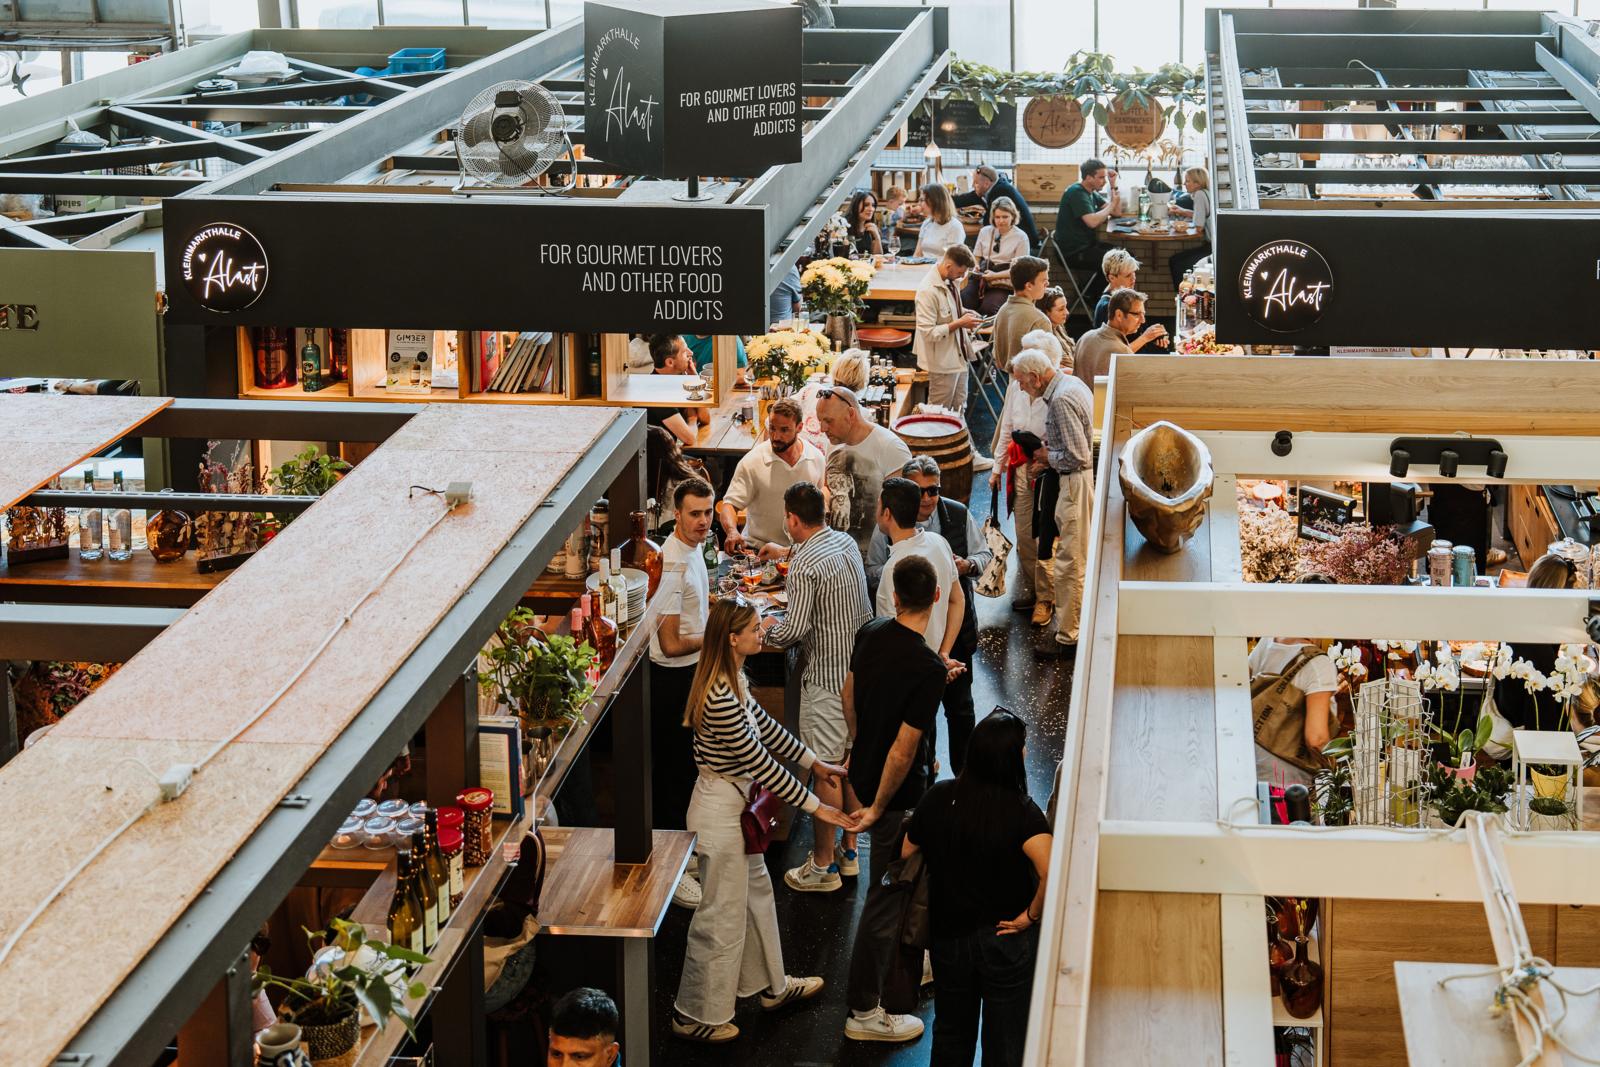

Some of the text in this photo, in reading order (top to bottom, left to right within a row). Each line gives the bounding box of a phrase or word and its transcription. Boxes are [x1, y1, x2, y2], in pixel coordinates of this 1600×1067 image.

[588, 27, 640, 106] KLEINMARKTHALLE
[680, 82, 796, 108] FOR GOURMET LOVERS
[707, 100, 796, 123] AND OTHER FOOD
[753, 118, 796, 136] ADDICTS
[182, 227, 242, 280] KLEINMARKTHALLE
[540, 244, 722, 266] FOR GOURMET LOVERS
[582, 272, 722, 293] AND OTHER FOOD
[1243, 245, 1308, 299] KLEINMARKTHALLE
[653, 300, 723, 321] ADDICTS
[1254, 704, 1274, 738] ECTION
